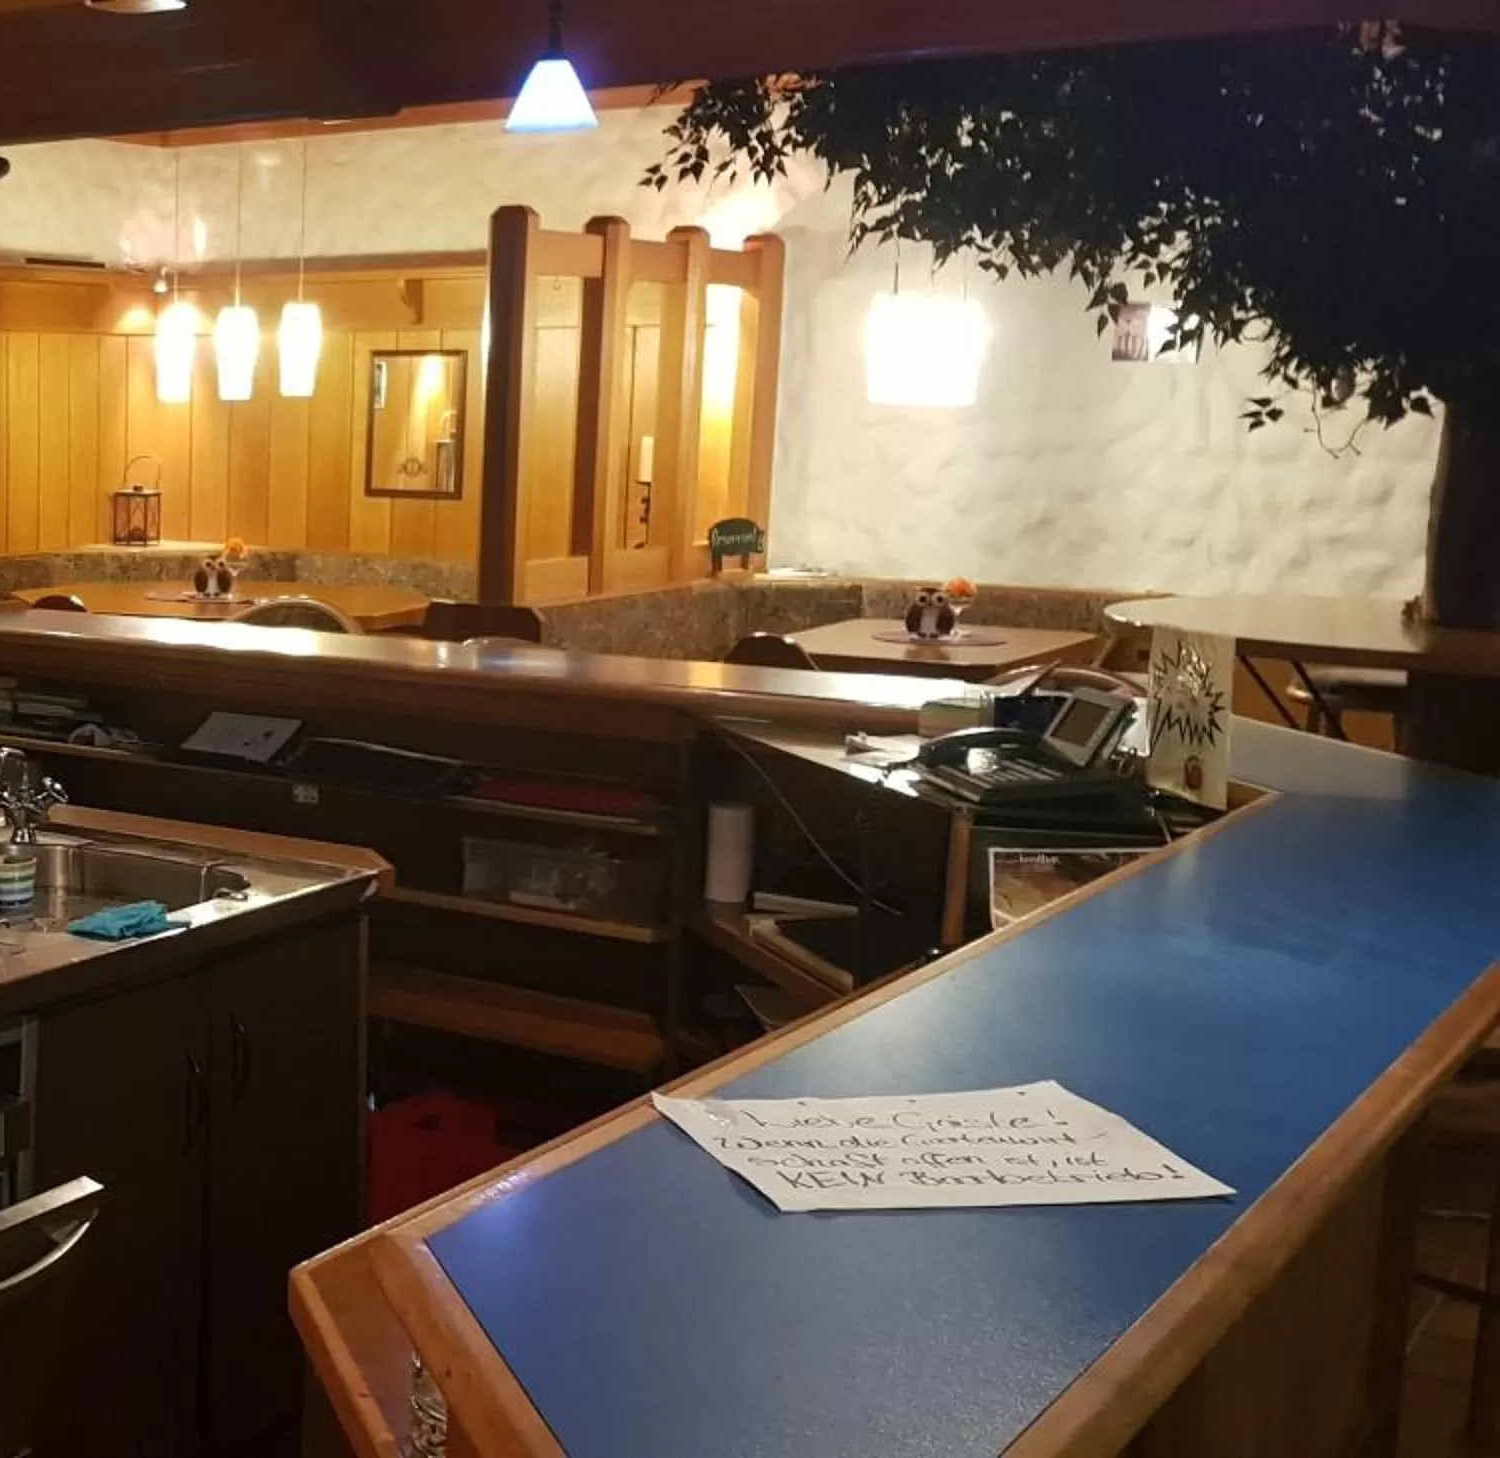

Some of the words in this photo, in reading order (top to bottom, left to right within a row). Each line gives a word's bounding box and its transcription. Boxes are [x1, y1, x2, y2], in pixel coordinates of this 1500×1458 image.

[712, 1135, 827, 1150] Wenn
[901, 1151, 986, 1168] offen
[1065, 1151, 1108, 1167] ist
[775, 1169, 886, 1189] KEIN
